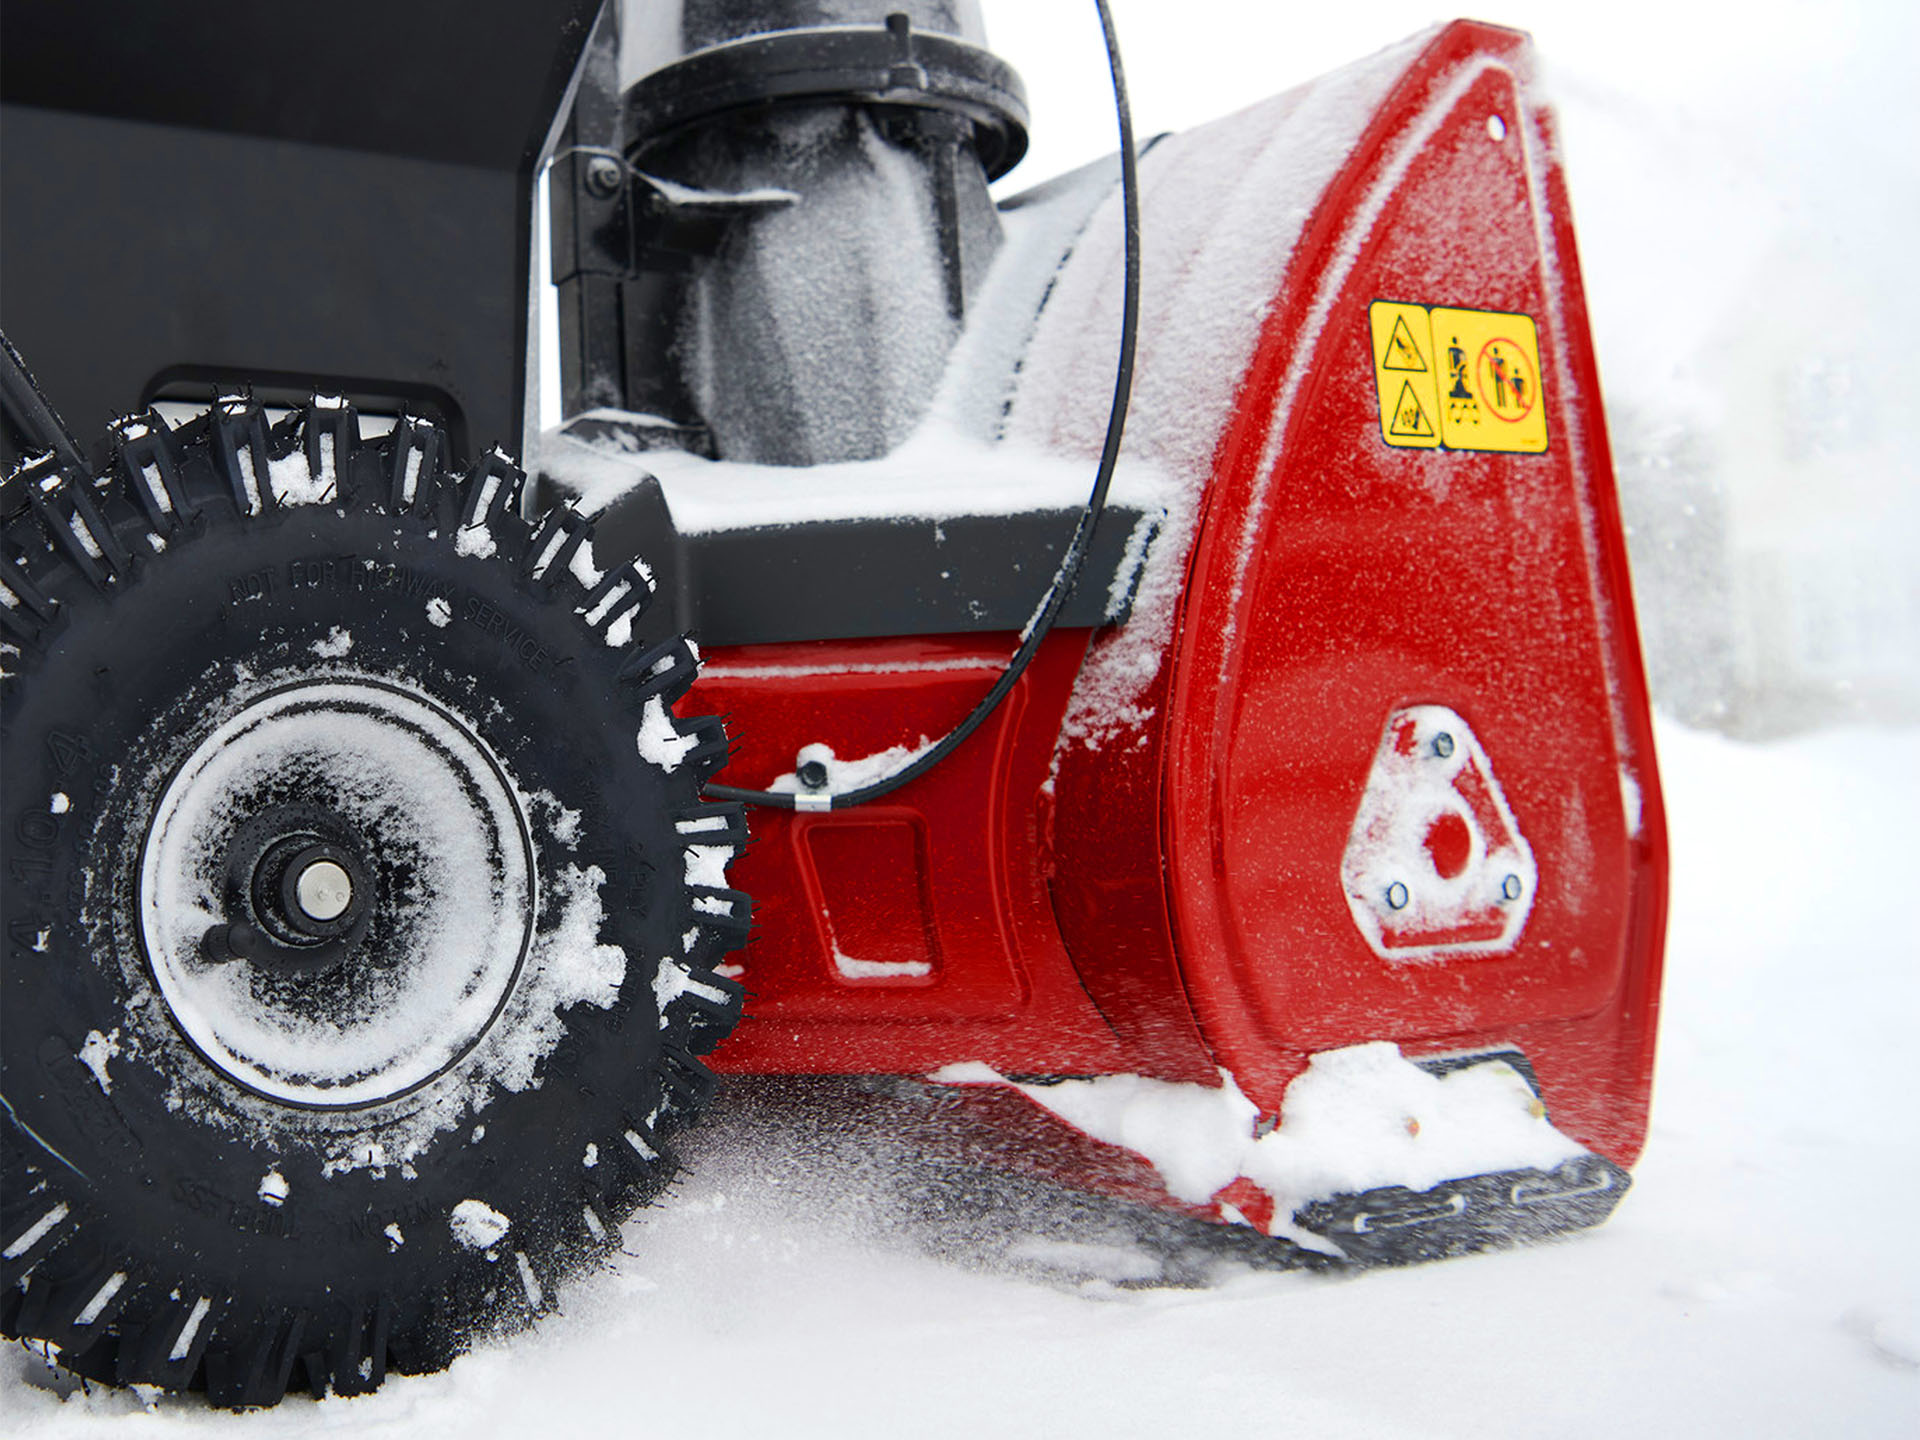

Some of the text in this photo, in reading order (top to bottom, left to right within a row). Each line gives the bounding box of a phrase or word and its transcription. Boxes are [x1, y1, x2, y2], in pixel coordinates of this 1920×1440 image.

[229, 559, 550, 672] NOT FOR HIGHWAY SERVICE
[627, 870, 648, 918] PLY
